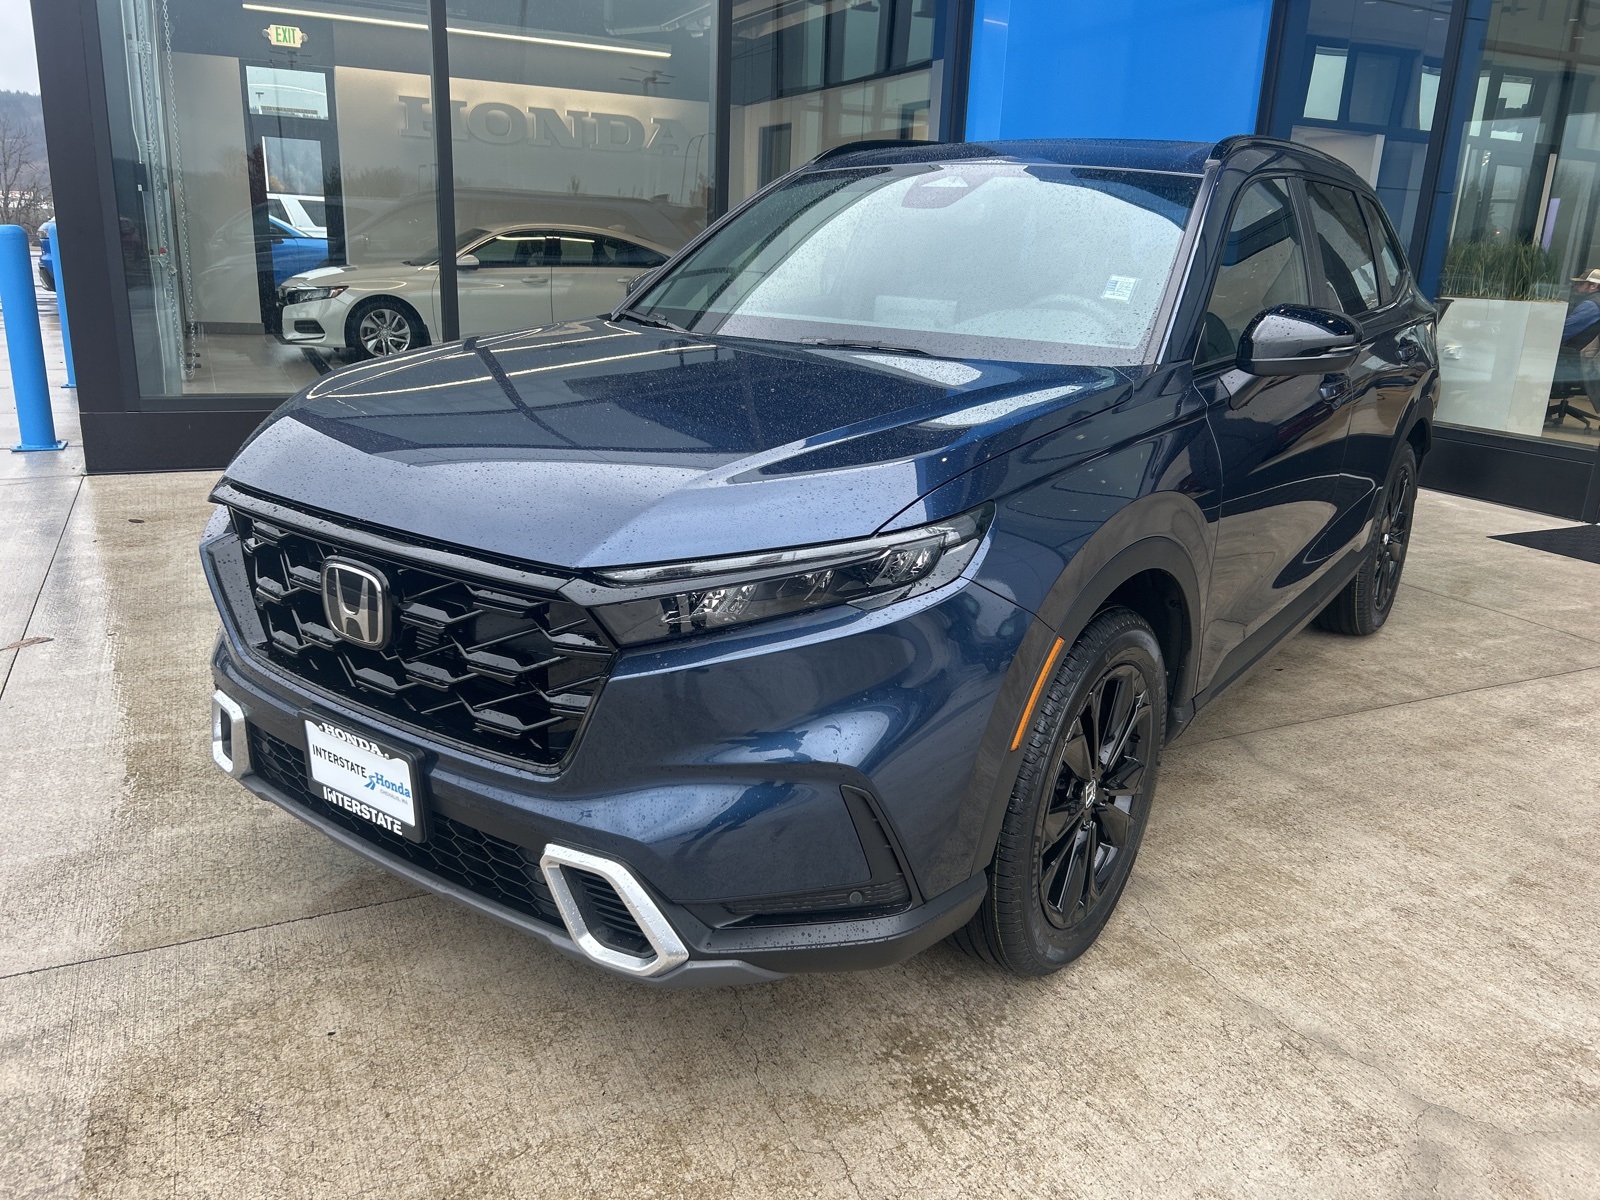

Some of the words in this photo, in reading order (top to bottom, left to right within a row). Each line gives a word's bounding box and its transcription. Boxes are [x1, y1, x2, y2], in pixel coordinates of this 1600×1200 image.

[275, 26, 296, 44] EXIT
[397, 94, 702, 157] HONDA
[322, 723, 383, 757] HONDA
[312, 744, 367, 779] INTERSTATE
[375, 772, 411, 798] Honda
[323, 786, 403, 836] INTERSTATE
